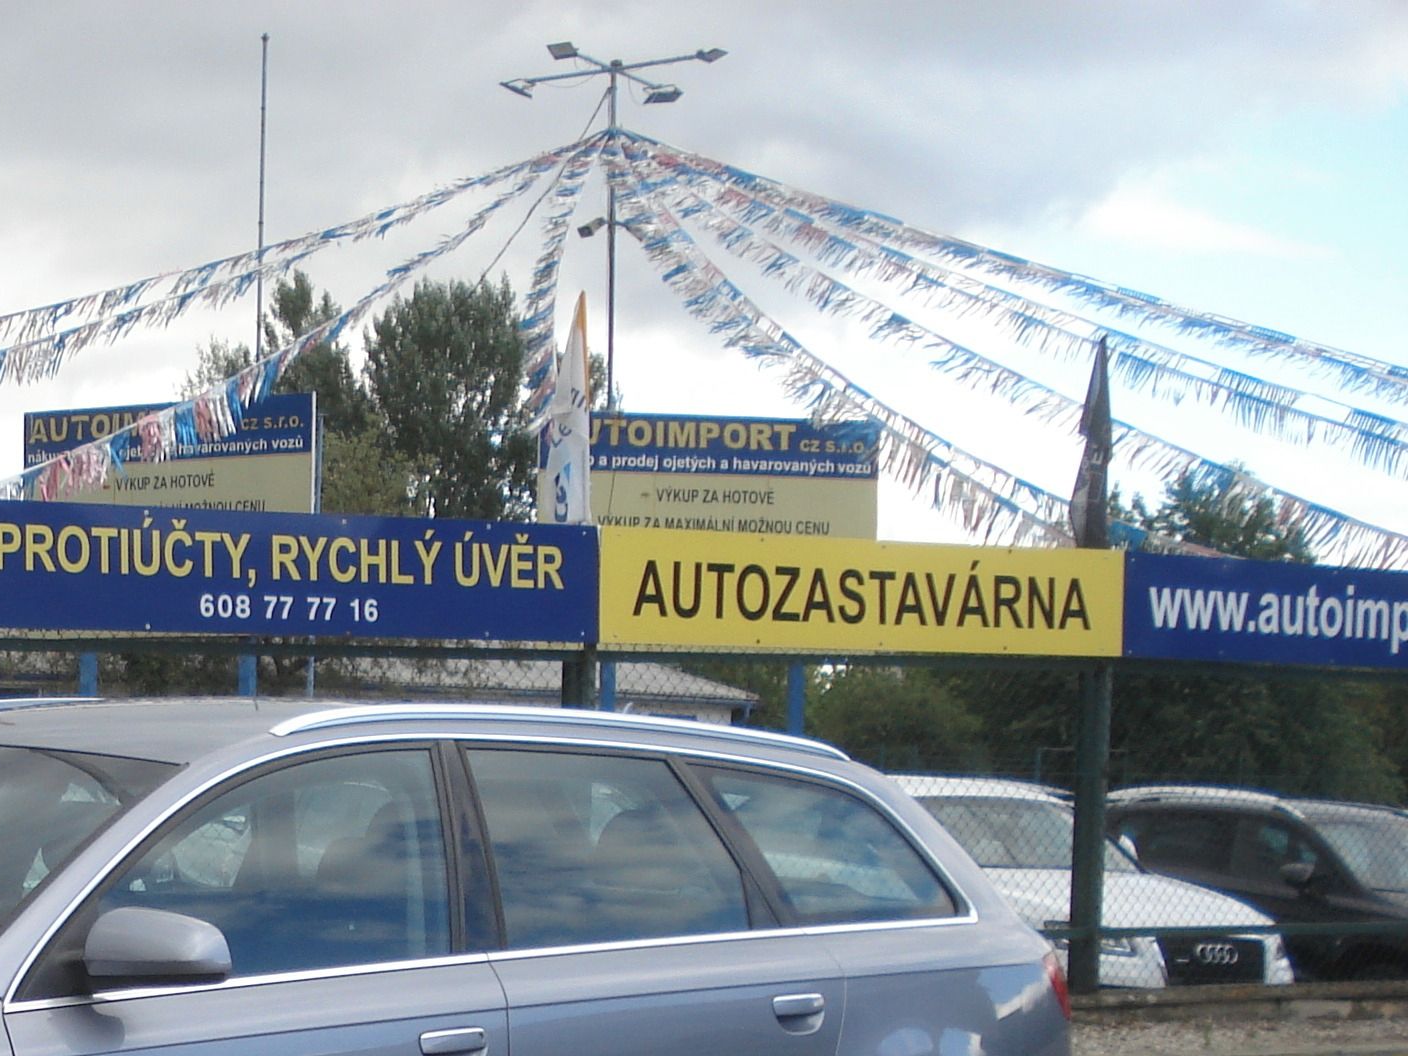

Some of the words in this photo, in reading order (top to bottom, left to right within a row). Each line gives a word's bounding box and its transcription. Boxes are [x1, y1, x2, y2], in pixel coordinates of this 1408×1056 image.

[263, 415, 304, 429] s.r.o.
[271, 435, 304, 450] vozů
[589, 418, 797, 451] TOIMPORT
[799, 439, 820, 453] cz
[598, 455, 608, 467] a
[612, 454, 659, 471] prodej
[663, 455, 716, 472] ojetých
[720, 459, 729, 470] a
[733, 456, 834, 475] havarovaných
[153, 475, 168, 490] ZA
[170, 469, 215, 489] HOTOVÉ
[656, 485, 699, 503] VÝKUP
[702, 489, 719, 504] ZA
[737, 516, 793, 534] MOŽNOU
[795, 520, 830, 536] CENU
[271, 529, 443, 586] RYCHLÝ
[454, 530, 565, 590] ÚVĚR
[632, 559, 1092, 632] AUTOZASTAVÁRNA
[199, 593, 252, 619] 608
[263, 596, 295, 621] 77
[306, 597, 338, 622] 77
[349, 599, 380, 623] 16
[1149, 583, 1408, 655] www.autoimp
